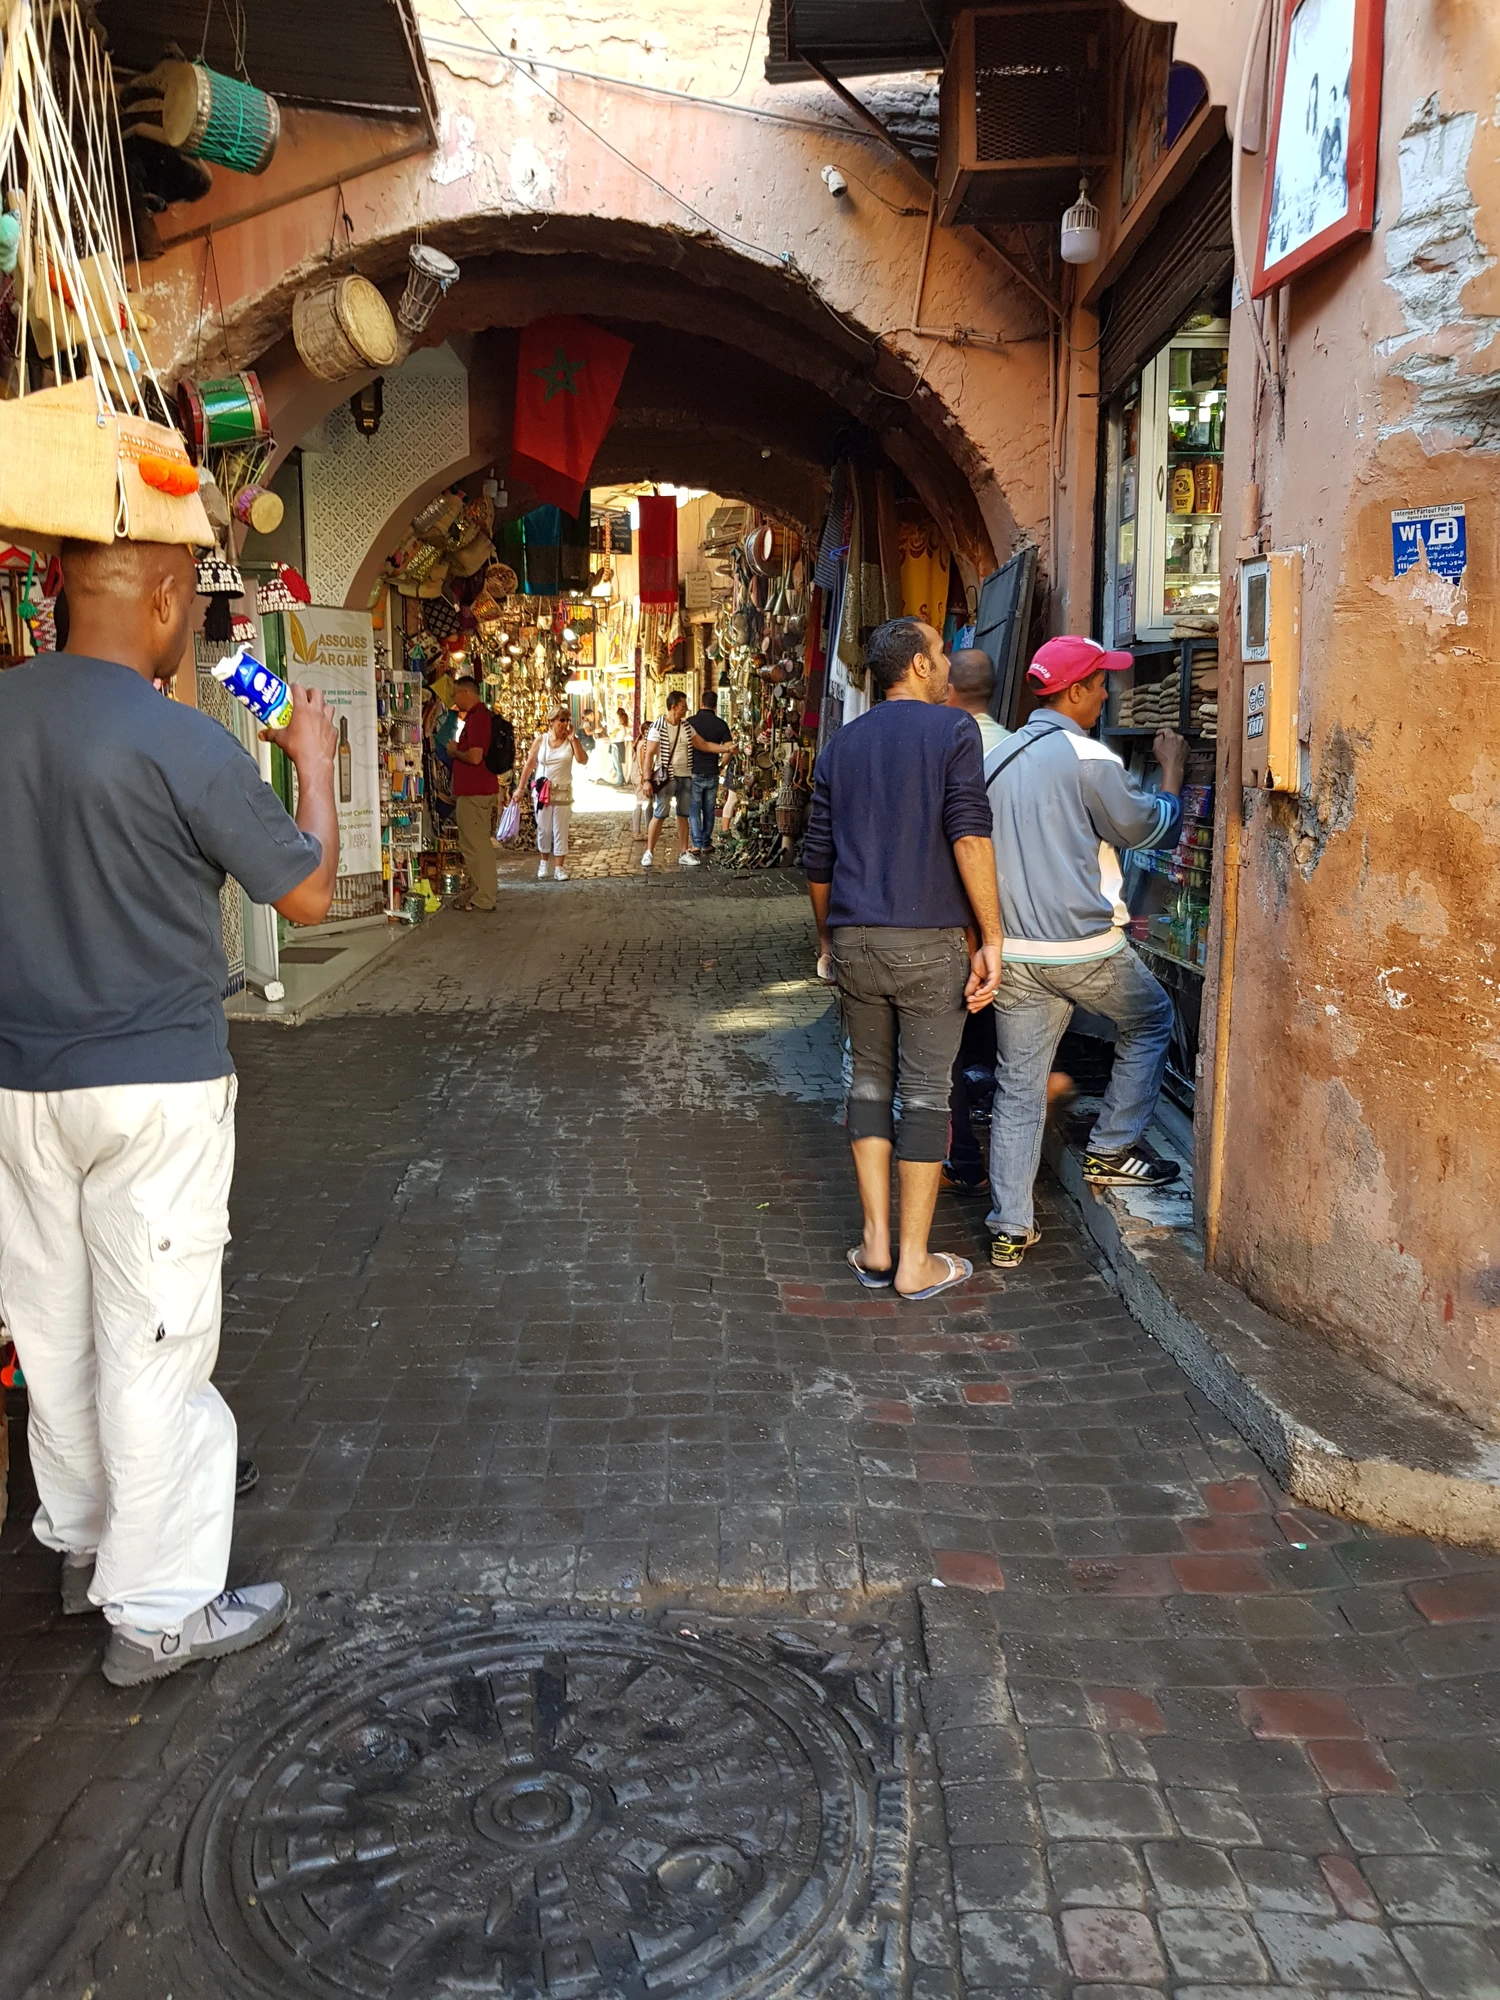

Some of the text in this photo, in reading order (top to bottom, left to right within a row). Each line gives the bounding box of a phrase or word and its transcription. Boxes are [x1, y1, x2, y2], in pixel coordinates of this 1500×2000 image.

[1394, 509, 1416, 517] Internet
[1416, 507, 1437, 515] Partout
[1399, 521, 1453, 542] Wi Fi
[318, 633, 368, 649] ASSOUSS
[319, 652, 368, 667] ARGANE
